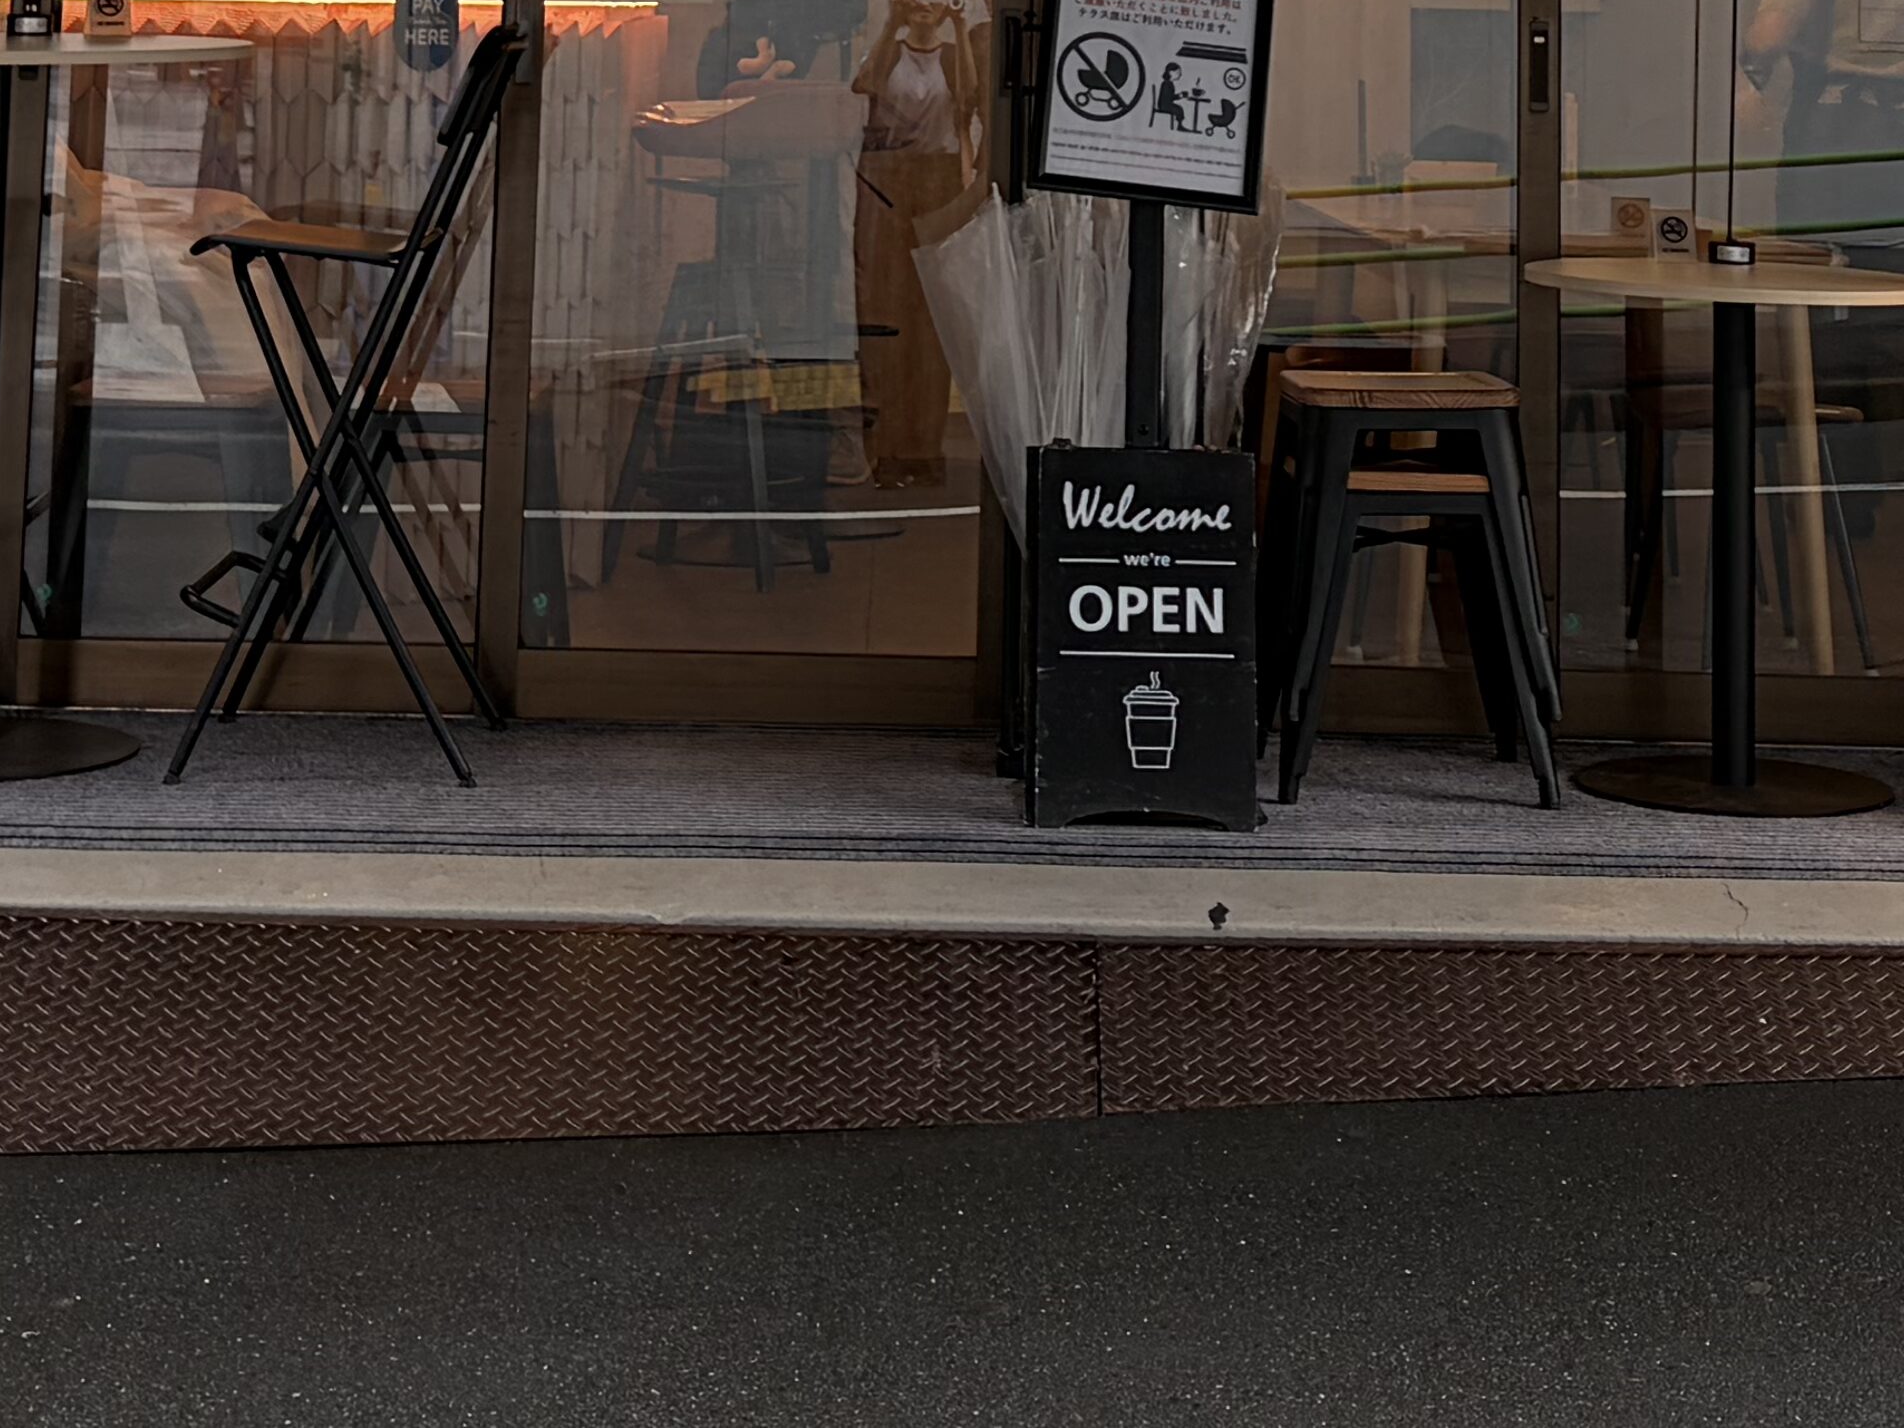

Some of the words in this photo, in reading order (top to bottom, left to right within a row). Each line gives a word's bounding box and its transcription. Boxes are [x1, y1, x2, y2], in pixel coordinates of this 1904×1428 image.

[404, 28, 450, 46] HERE
[1062, 480, 1232, 533] Welcome
[1124, 552, 1171, 568] we're
[1068, 584, 1224, 634] OPEN
